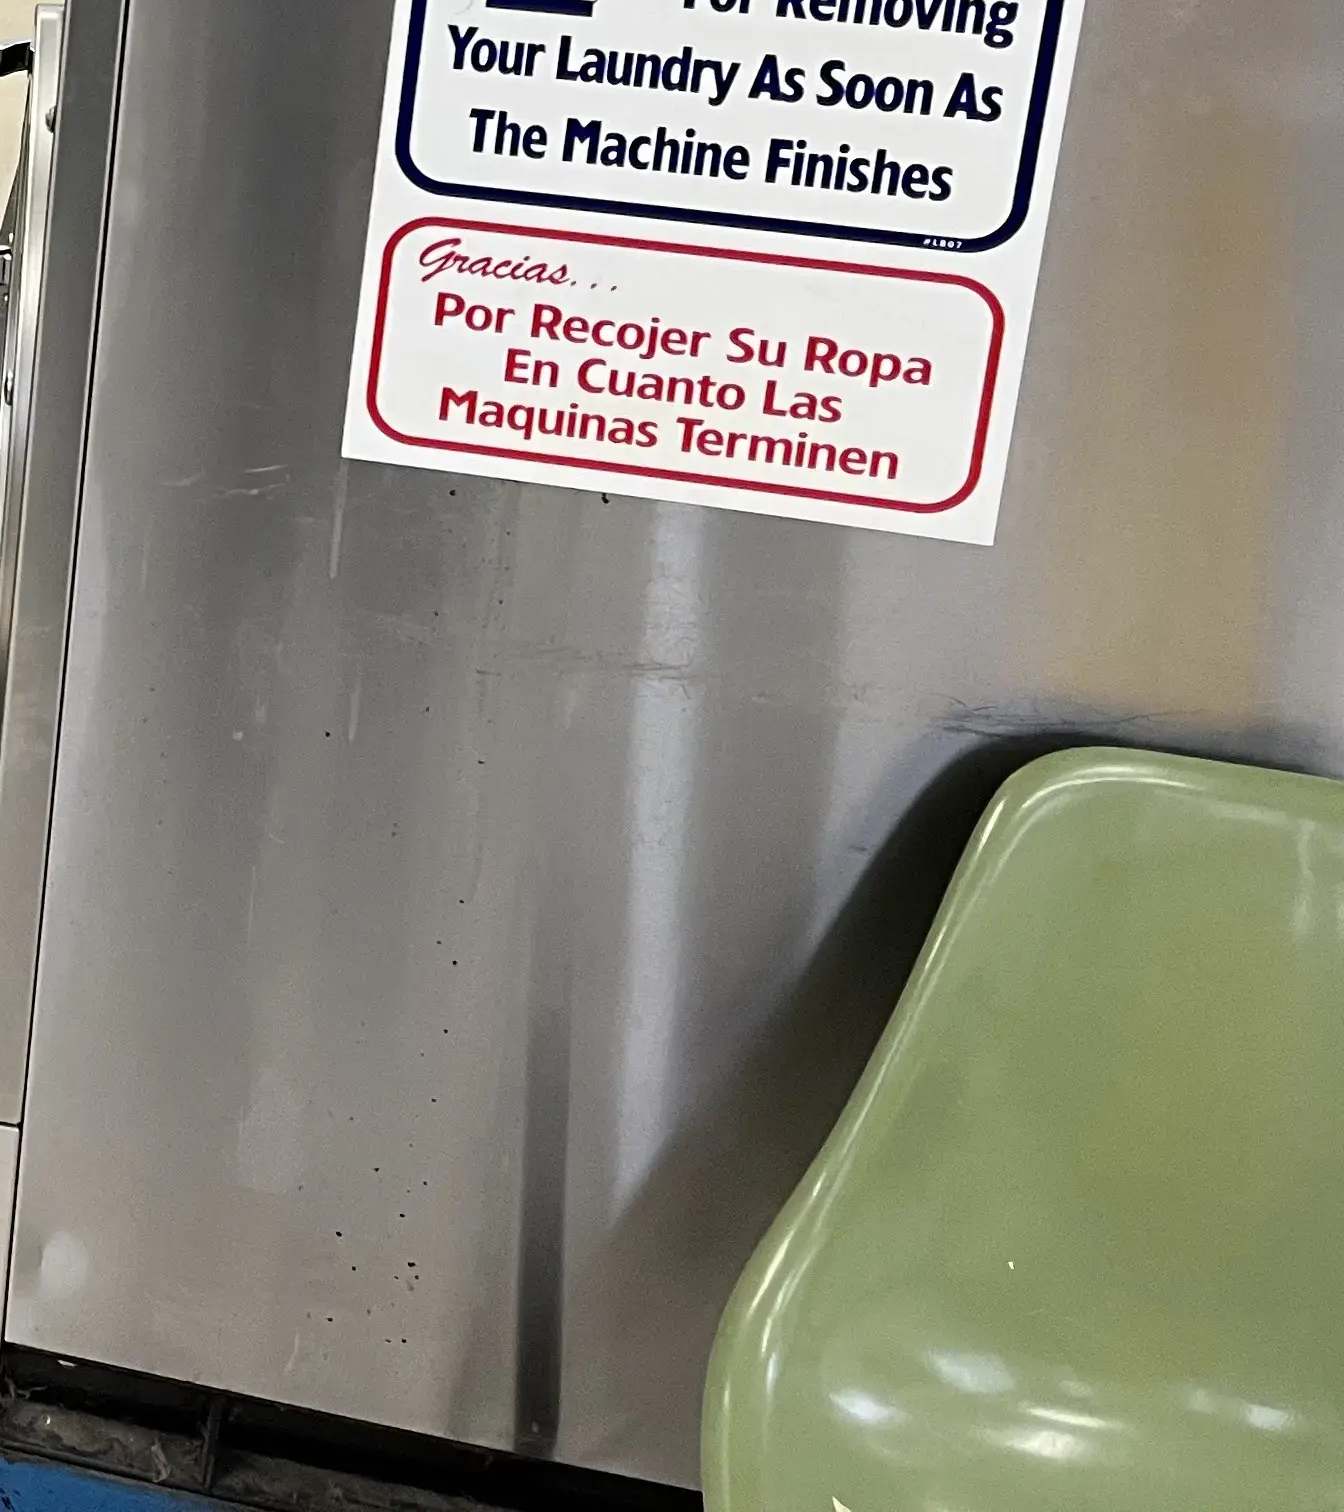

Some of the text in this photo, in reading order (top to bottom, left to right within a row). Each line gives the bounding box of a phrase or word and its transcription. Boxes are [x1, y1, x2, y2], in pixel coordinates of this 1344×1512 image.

[447, 24, 1003, 124] Your Laundry As Soon As
[469, 107, 955, 203] The Machine Finishes
[418, 237, 619, 291] Gracias...
[433, 291, 934, 389] Por Recojer Su Ropa
[503, 347, 844, 424] En Cuanto Las
[438, 386, 900, 481] Maquinas Terminen
